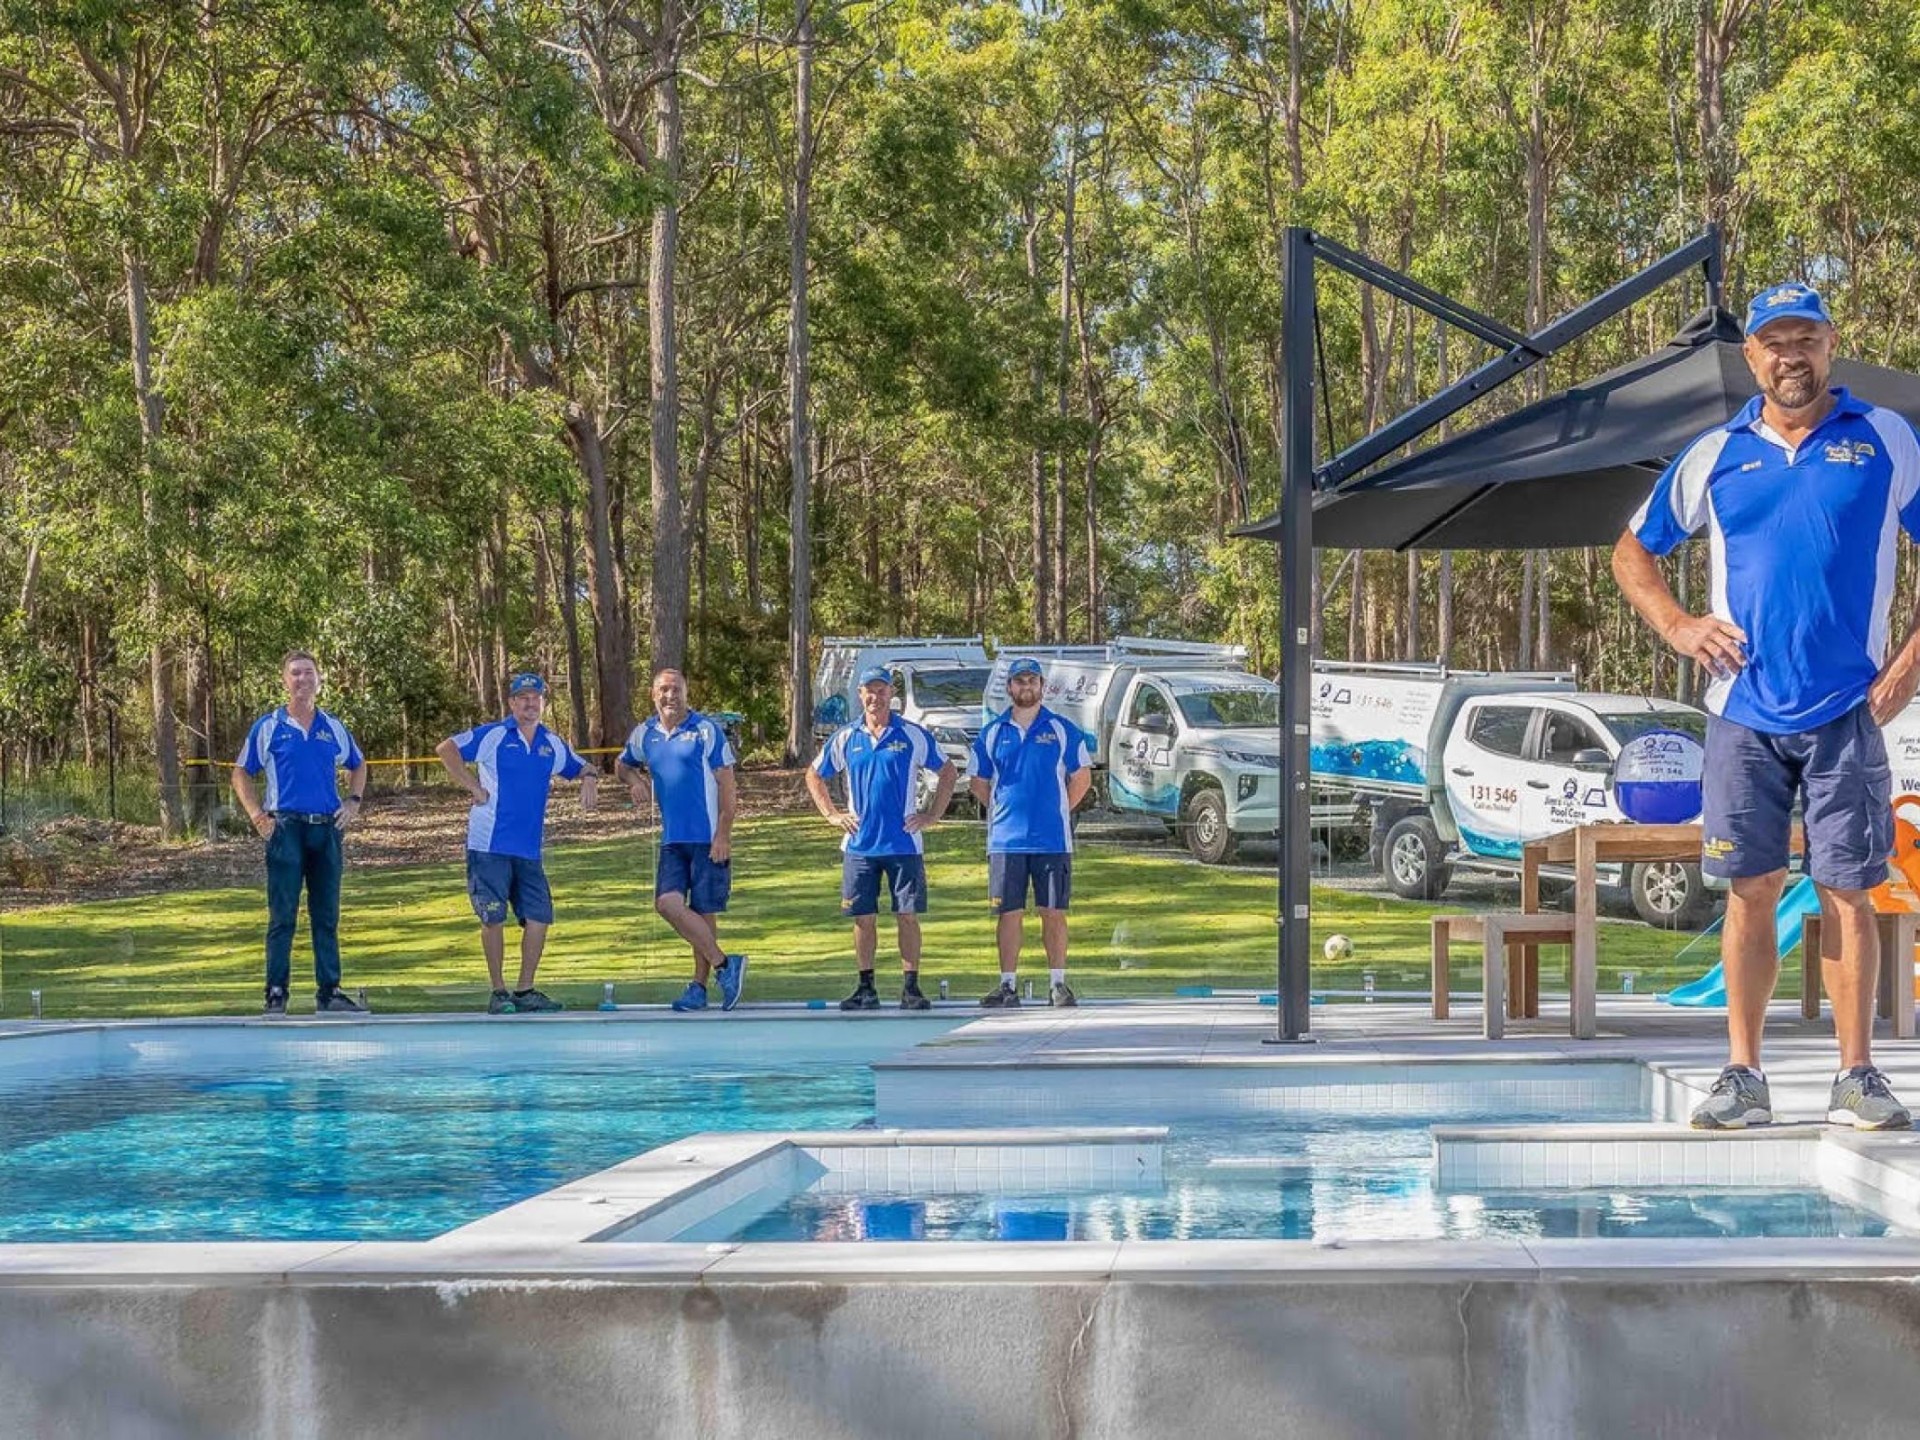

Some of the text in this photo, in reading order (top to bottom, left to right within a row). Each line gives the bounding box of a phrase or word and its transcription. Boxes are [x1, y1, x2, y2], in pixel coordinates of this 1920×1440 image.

[1471, 785, 1517, 804] 131 546
[1550, 806, 1586, 819] Pool Care
